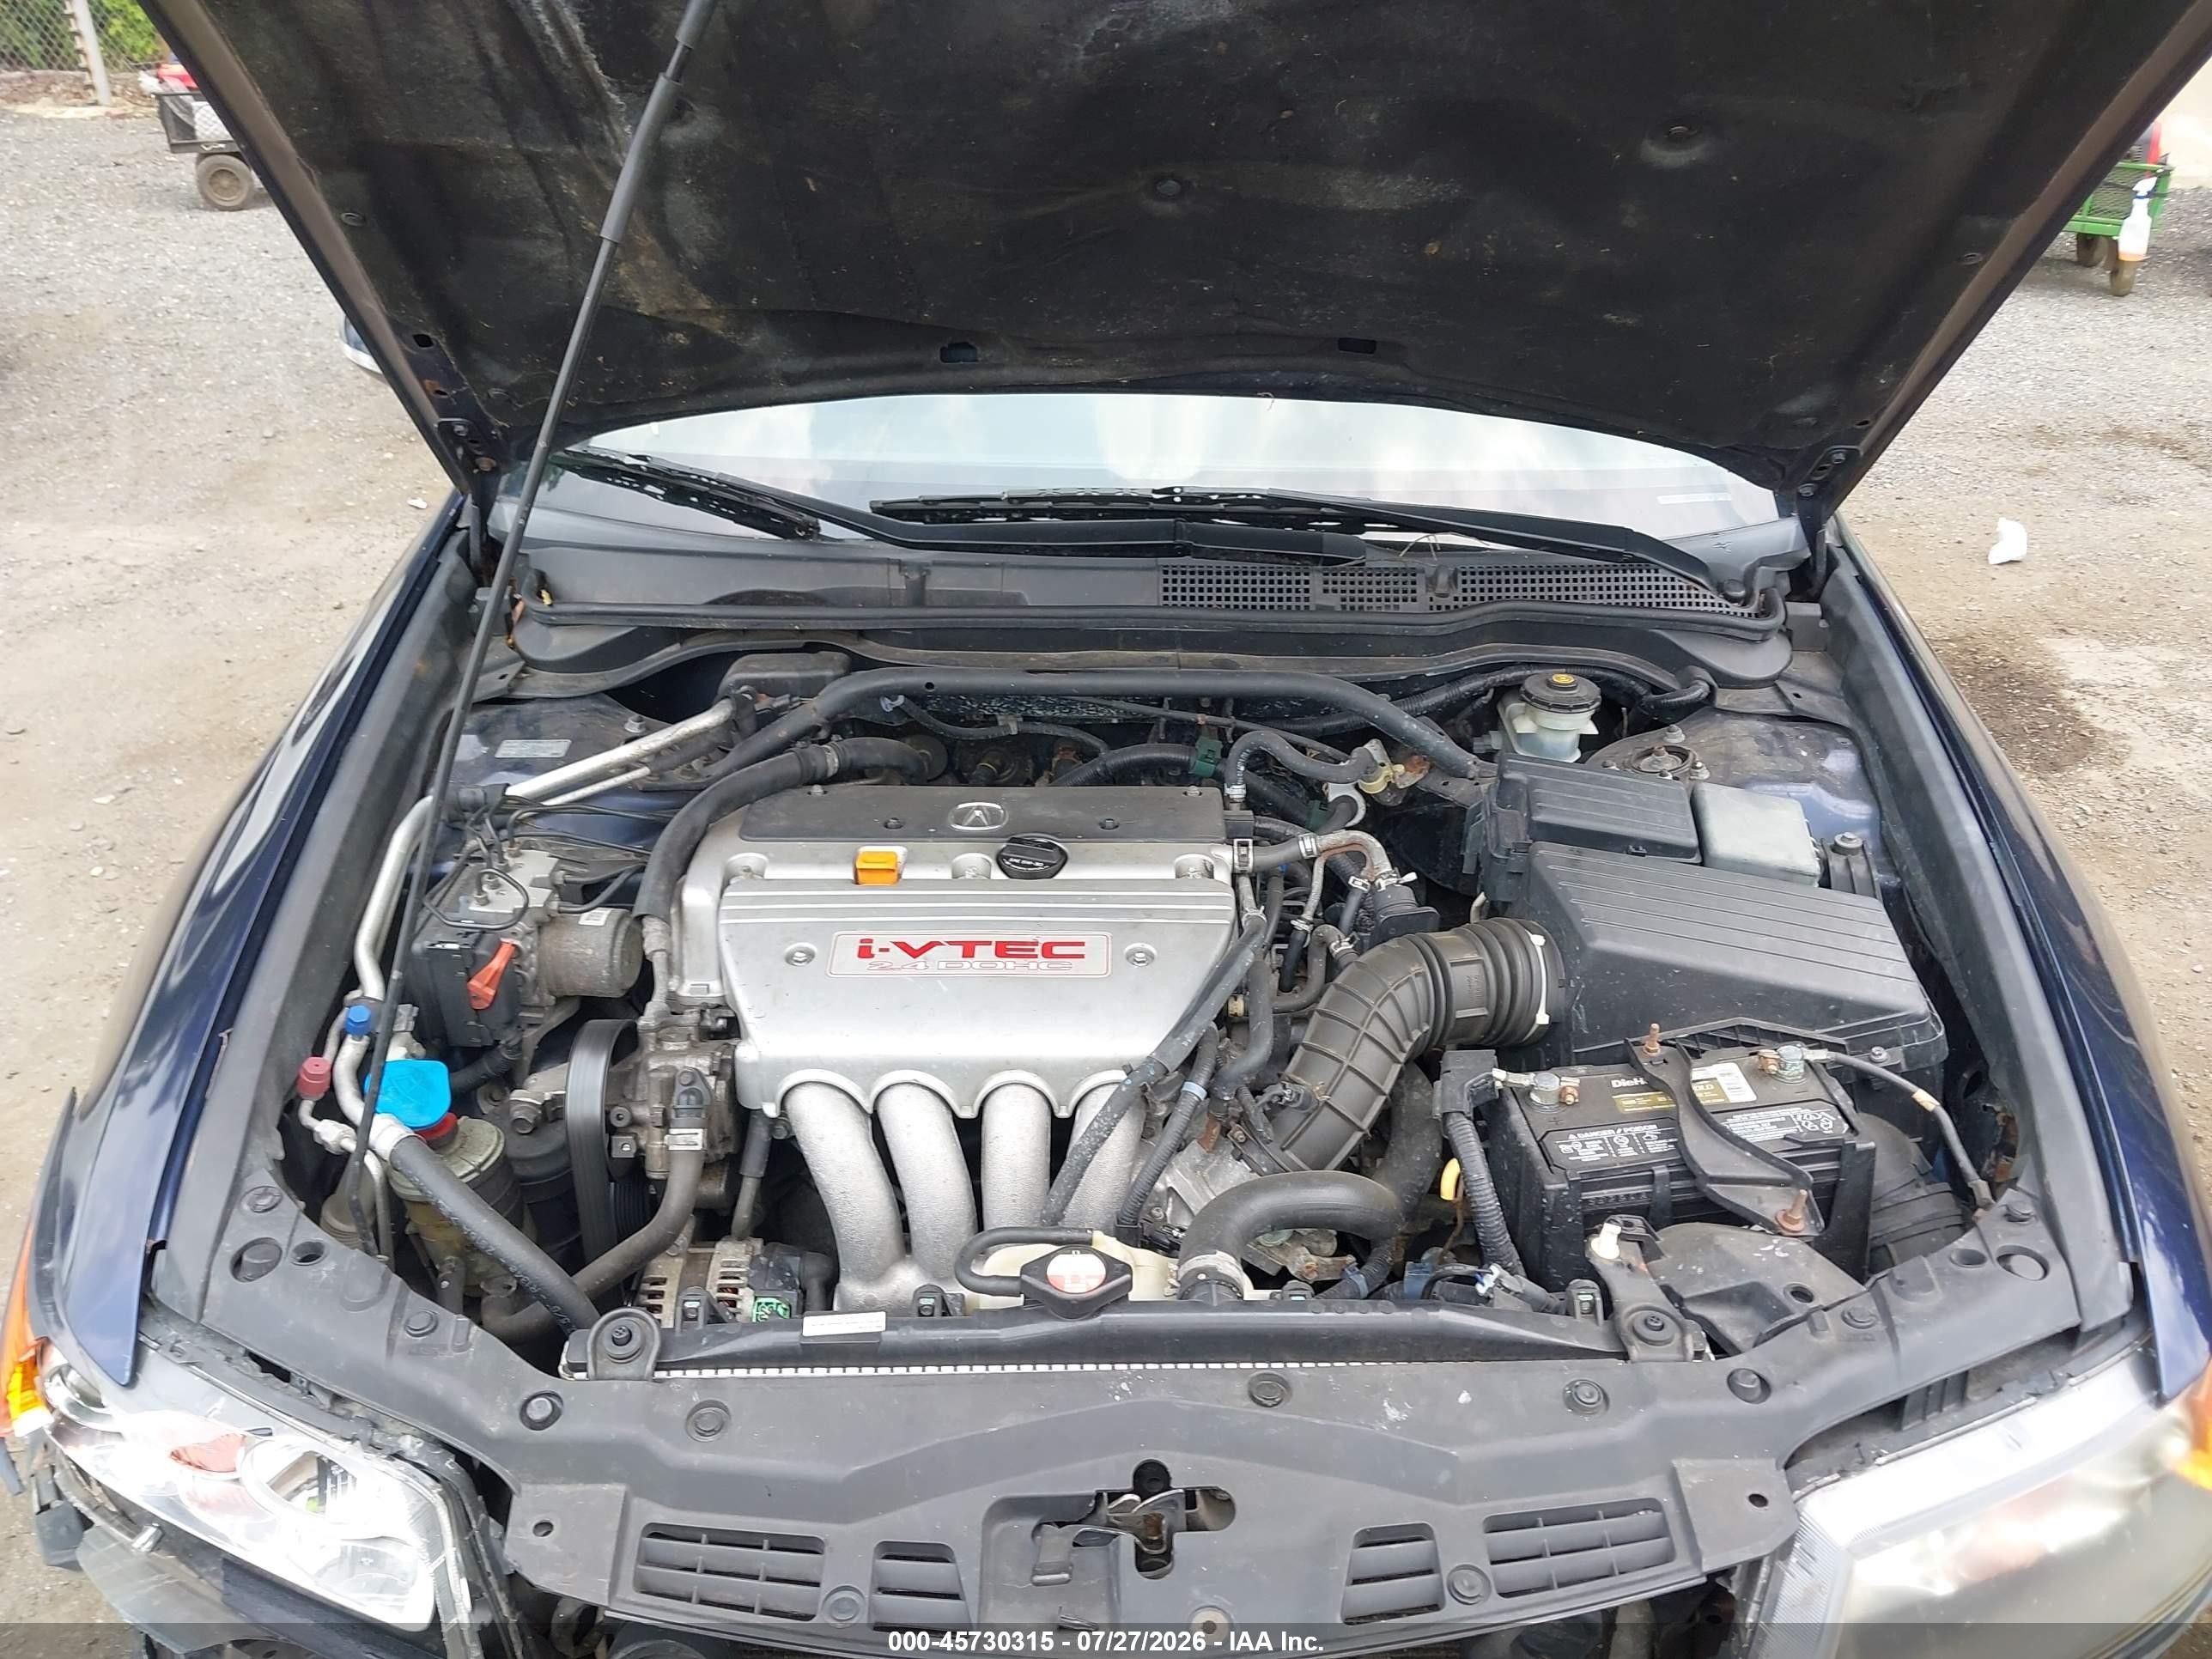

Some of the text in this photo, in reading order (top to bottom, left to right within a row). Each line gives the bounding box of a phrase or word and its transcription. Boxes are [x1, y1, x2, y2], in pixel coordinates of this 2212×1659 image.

[857, 938, 1085, 959] i-VTEC
[866, 959, 1073, 971] 2.4 DOHC
